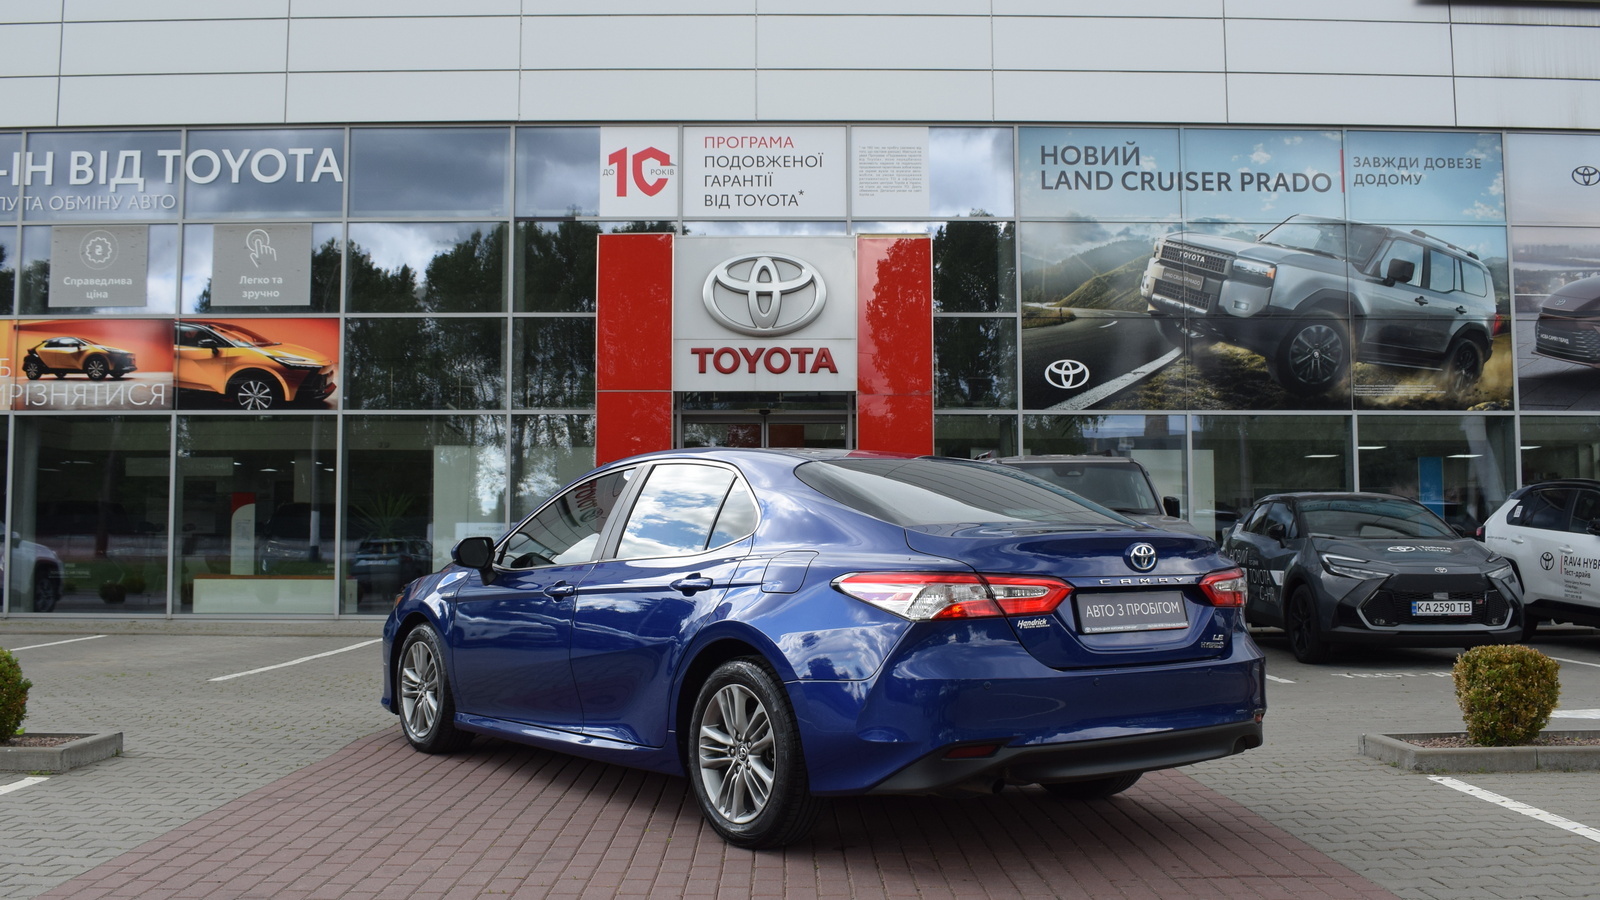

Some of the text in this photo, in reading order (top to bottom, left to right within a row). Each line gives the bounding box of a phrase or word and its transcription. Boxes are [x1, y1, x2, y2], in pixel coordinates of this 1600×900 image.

[704, 136, 794, 149] ПРОГРАМА
[1041, 141, 1140, 166] НОВИЙ
[704, 152, 824, 171] ПОДОВЖЕНОЇ
[1353, 156, 1482, 171] ЗАВЖДИ ДОВЕЗЕ
[69, 150, 145, 192] ВІД
[157, 147, 343, 184] TOYOTA
[602, 168, 615, 176] ДО
[650, 168, 675, 176] РОКІВ
[704, 172, 773, 187] ГАРАНТІЇ
[1041, 170, 1332, 193] LAND CRUISER PRADO
[1353, 174, 1422, 187] ДОДОМУ
[25, 196, 43, 211] ТА
[50, 195, 123, 211] ОБМІНУ
[127, 194, 176, 209] АВТО
[704, 194, 731, 209] ВІД
[1179, 251, 1205, 263] TOYOTA
[63, 276, 133, 287] Справедлива
[239, 275, 283, 285] Легко та
[86, 289, 109, 299] ціна
[242, 289, 280, 299] зручно
[691, 347, 839, 374] TOYOTA
[0, 383, 165, 406] РІЗНЯТИСЯ
[1563, 555, 1581, 567] RAV4
[1249, 568, 1272, 585] TOYOTA
[1564, 568, 1591, 579] Тест-драйв
[1099, 577, 1183, 585] CAMRY
[1259, 585, 1277, 602] C-HR
[1086, 604, 1115, 618] АВТО
[1126, 601, 1180, 616] ПРОБІГОМ
[1417, 602, 1471, 612] KA 2590 TB
[1017, 618, 1047, 629] Hendrick
